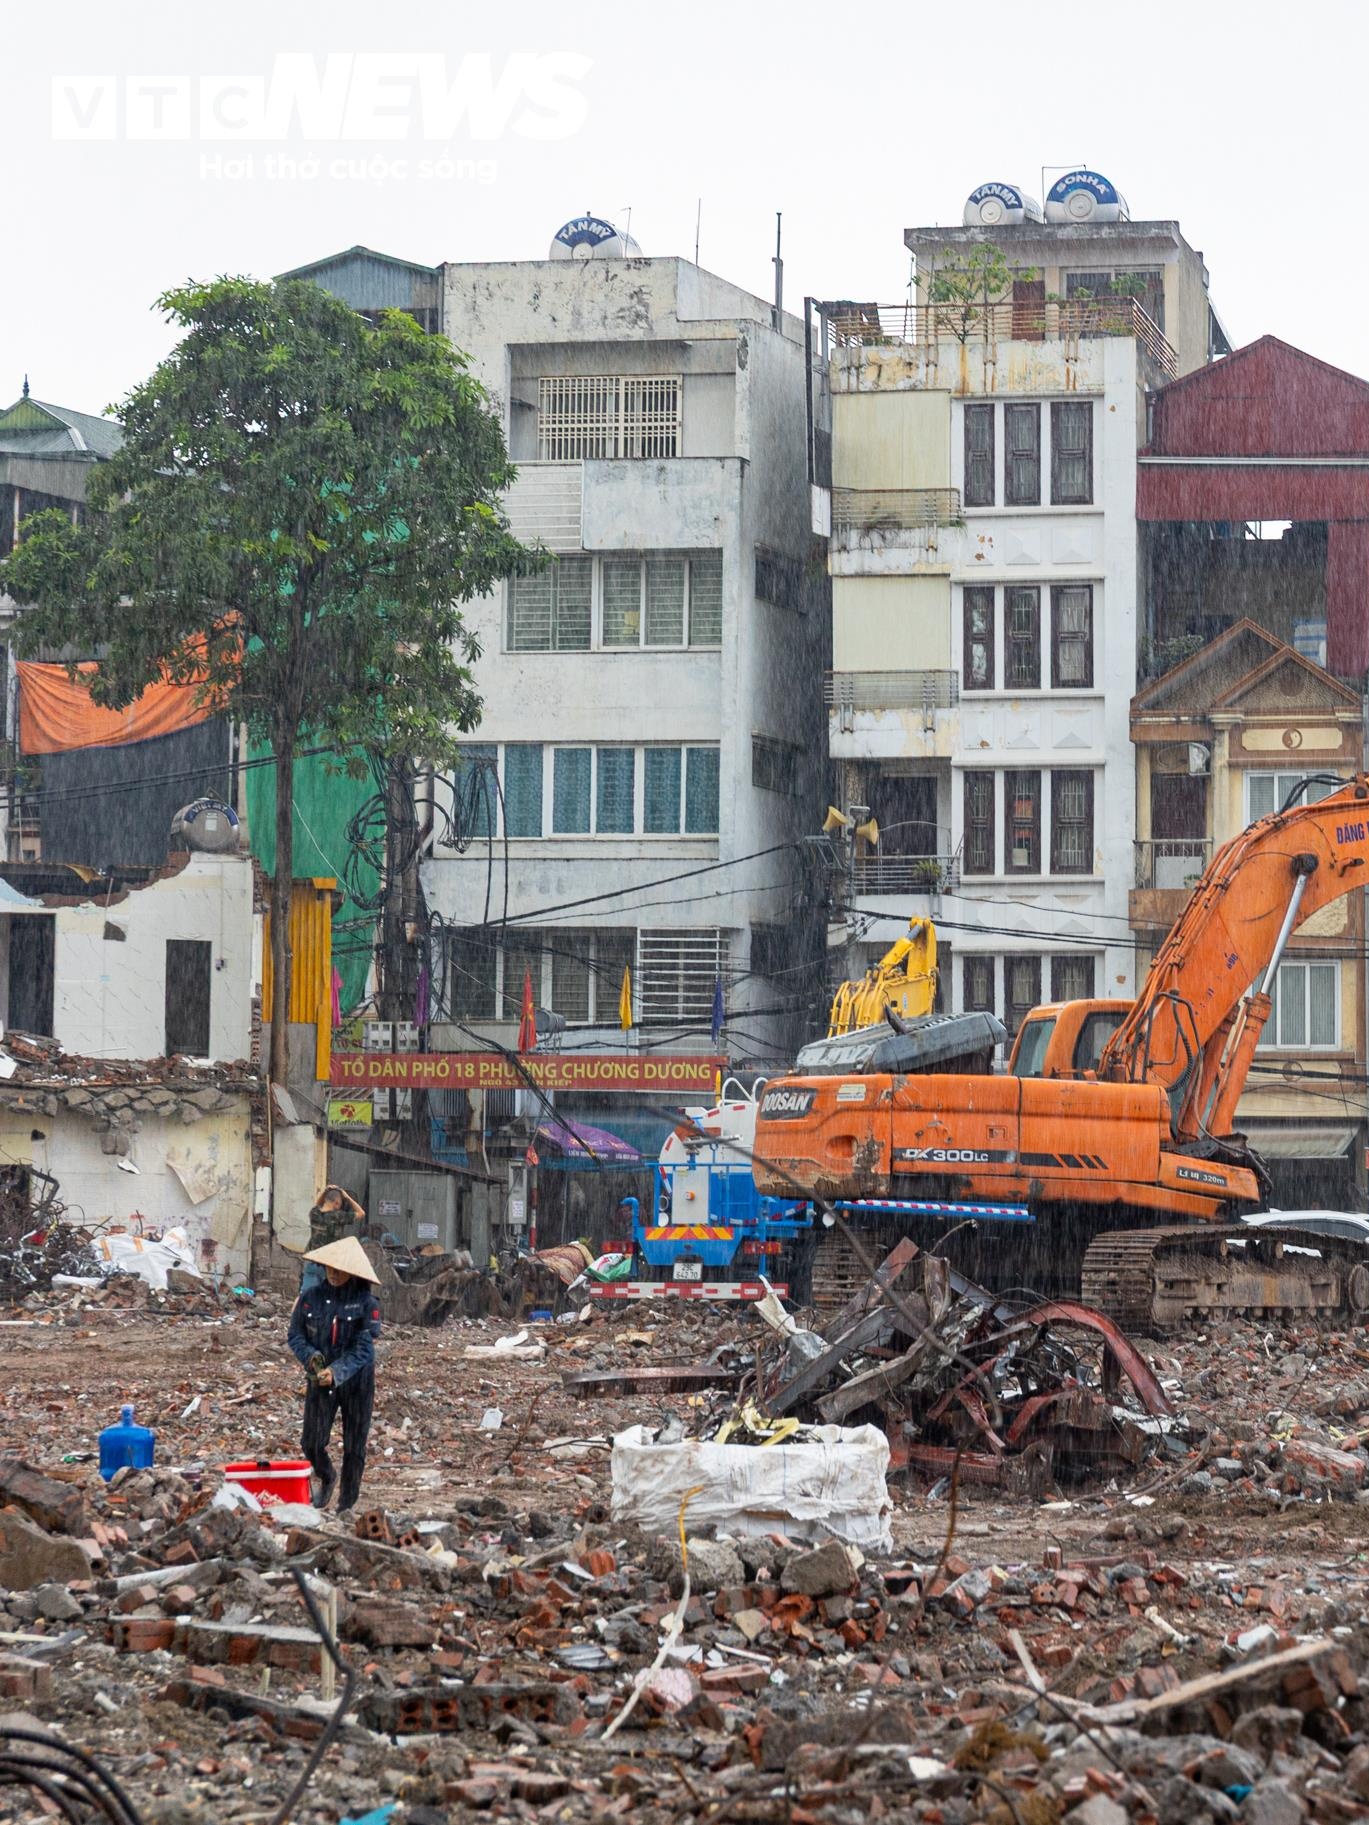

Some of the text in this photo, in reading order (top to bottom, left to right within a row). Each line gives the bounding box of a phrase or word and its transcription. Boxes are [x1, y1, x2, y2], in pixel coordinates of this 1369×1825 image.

[341, 1056, 366, 1077] TỔ
[368, 1057, 408, 1077] DÂN
[411, 1056, 450, 1078] PHỐ
[455, 1060, 475, 1078] 18
[561, 1060, 640, 1080] CHƯƠNG
[643, 1061, 711, 1080] DƯƠNG
